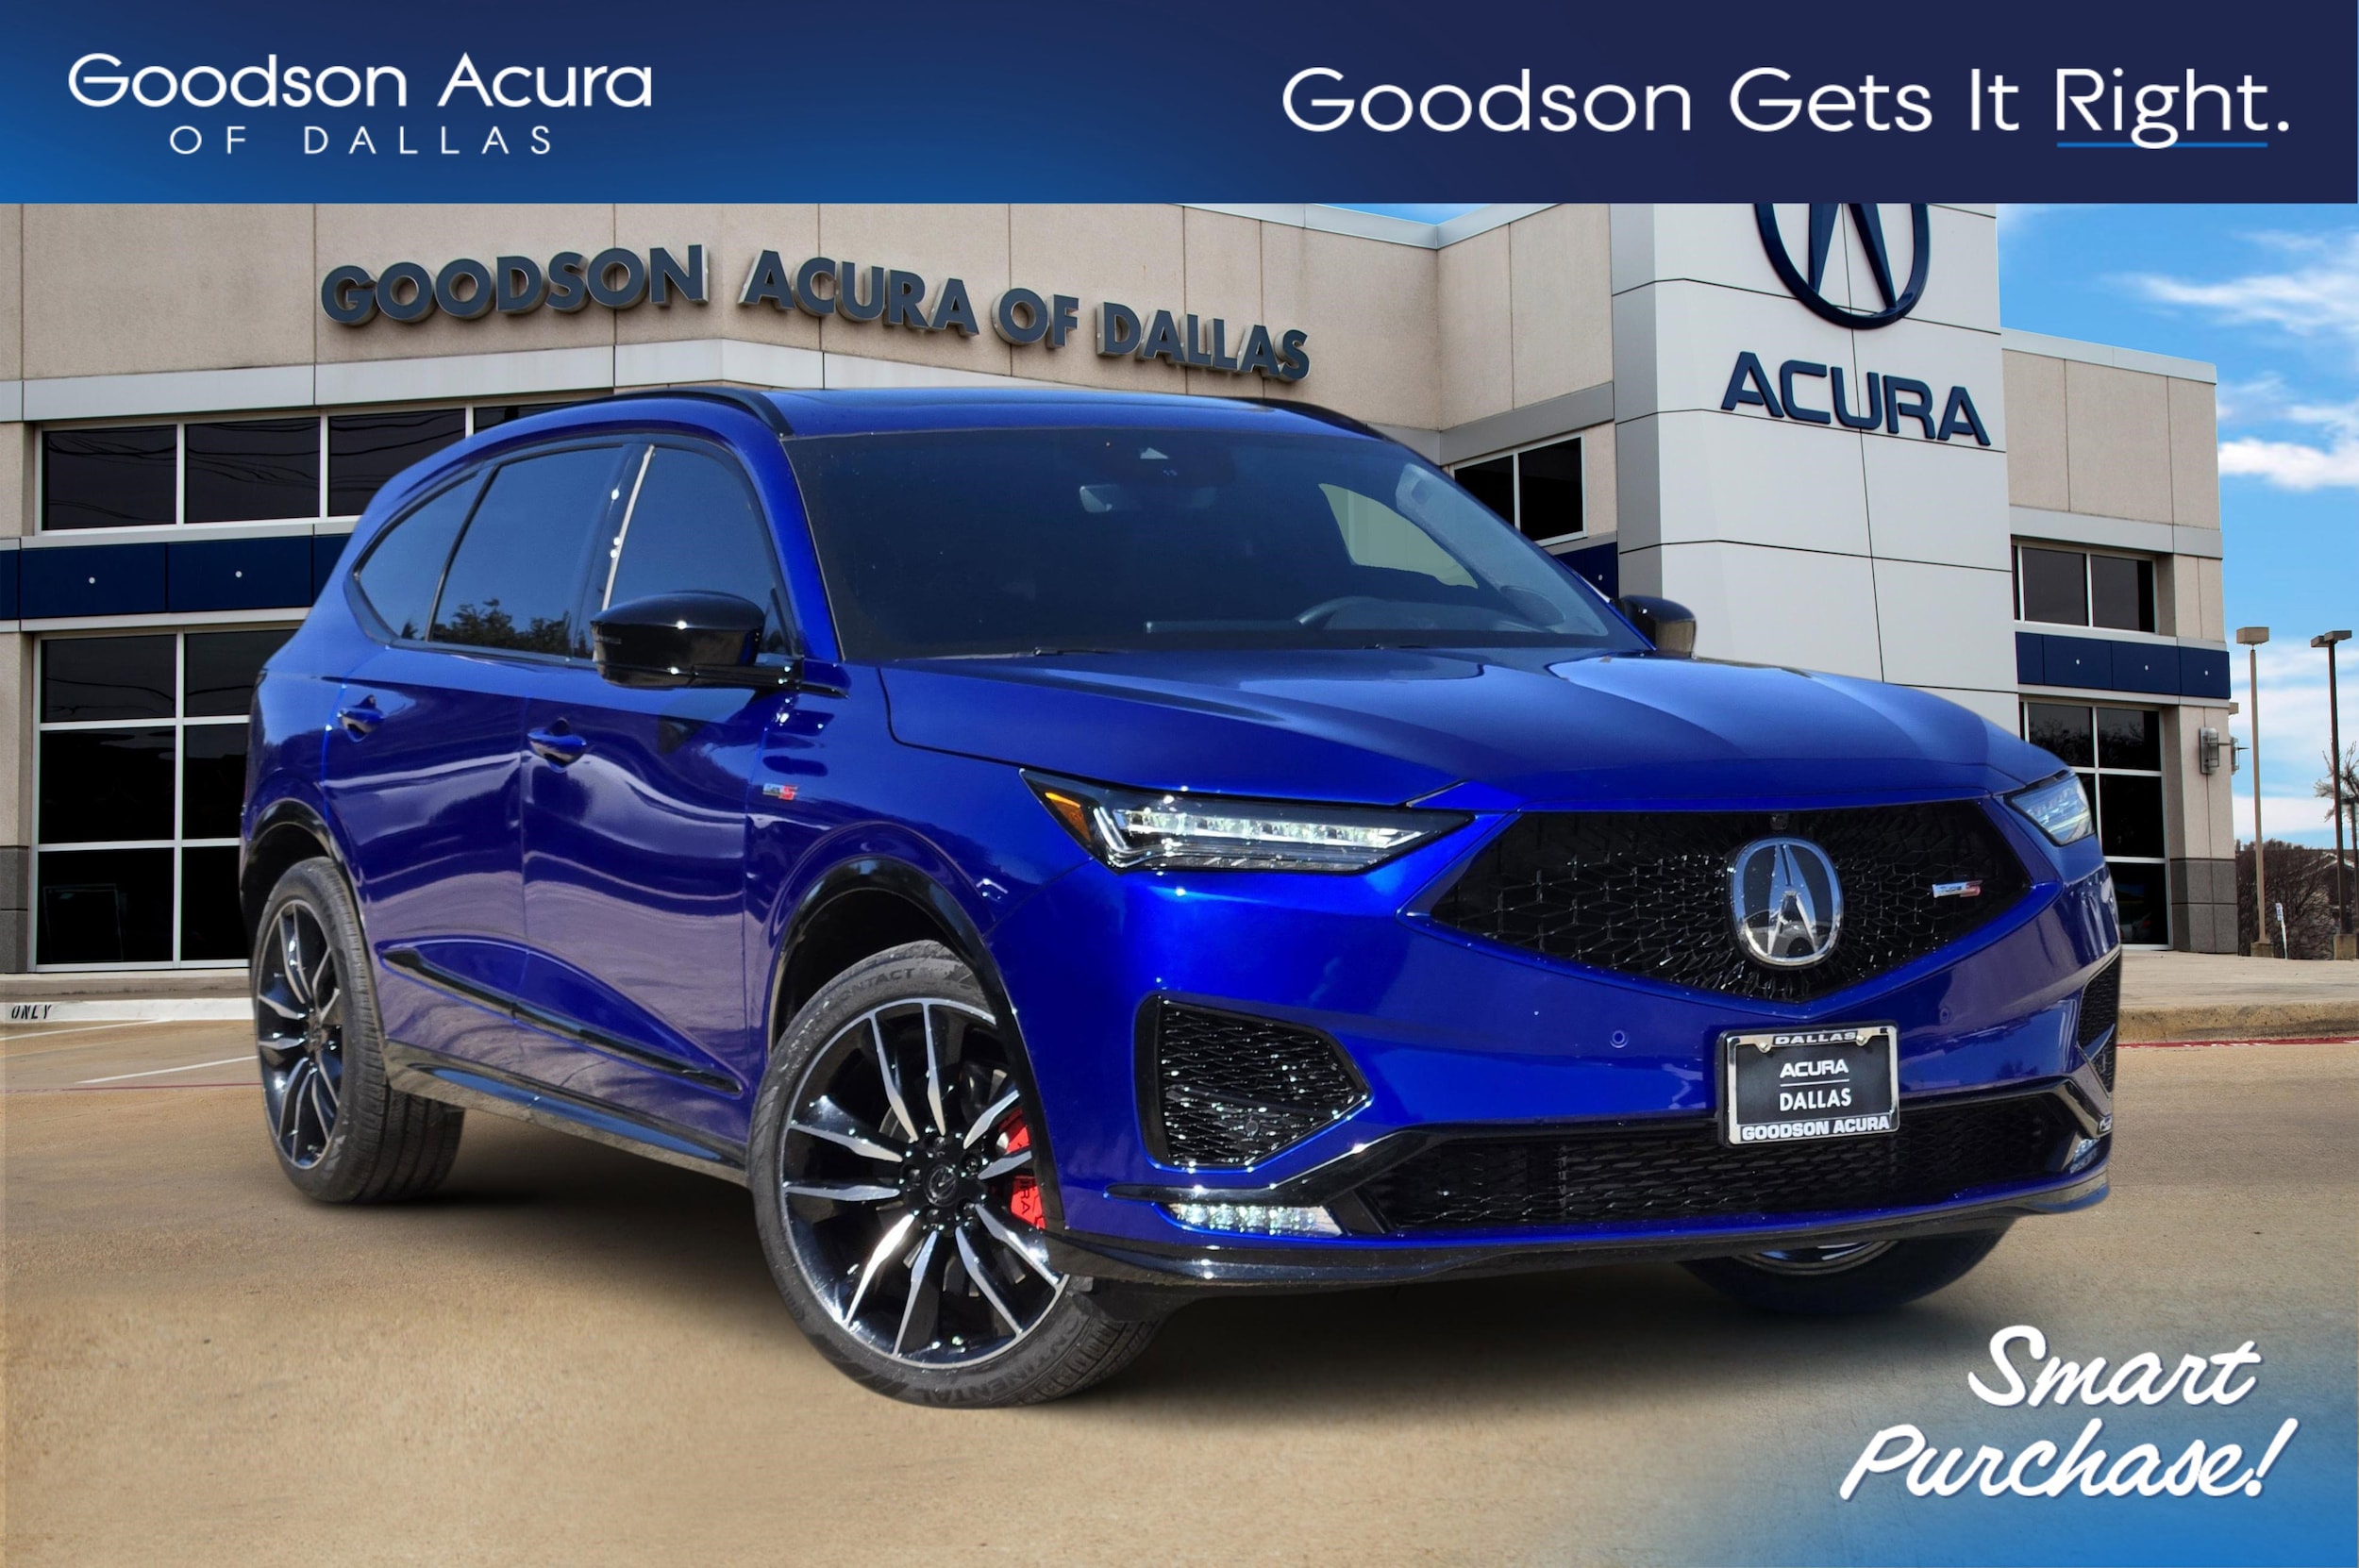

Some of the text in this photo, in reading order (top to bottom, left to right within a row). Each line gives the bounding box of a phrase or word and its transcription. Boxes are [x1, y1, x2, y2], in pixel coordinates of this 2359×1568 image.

[321, 244, 1311, 382] GOODSON ACURA OF DALLAS
[1720, 350, 1991, 446] ACURA
[11, 1004, 52, 1020] ONLY
[1774, 1031, 1858, 1045] DALLAS
[1779, 1059, 1849, 1079] ACURA
[1779, 1087, 1852, 1112] DALLAS
[1742, 1114, 1891, 1143] GOODSON ACURA
